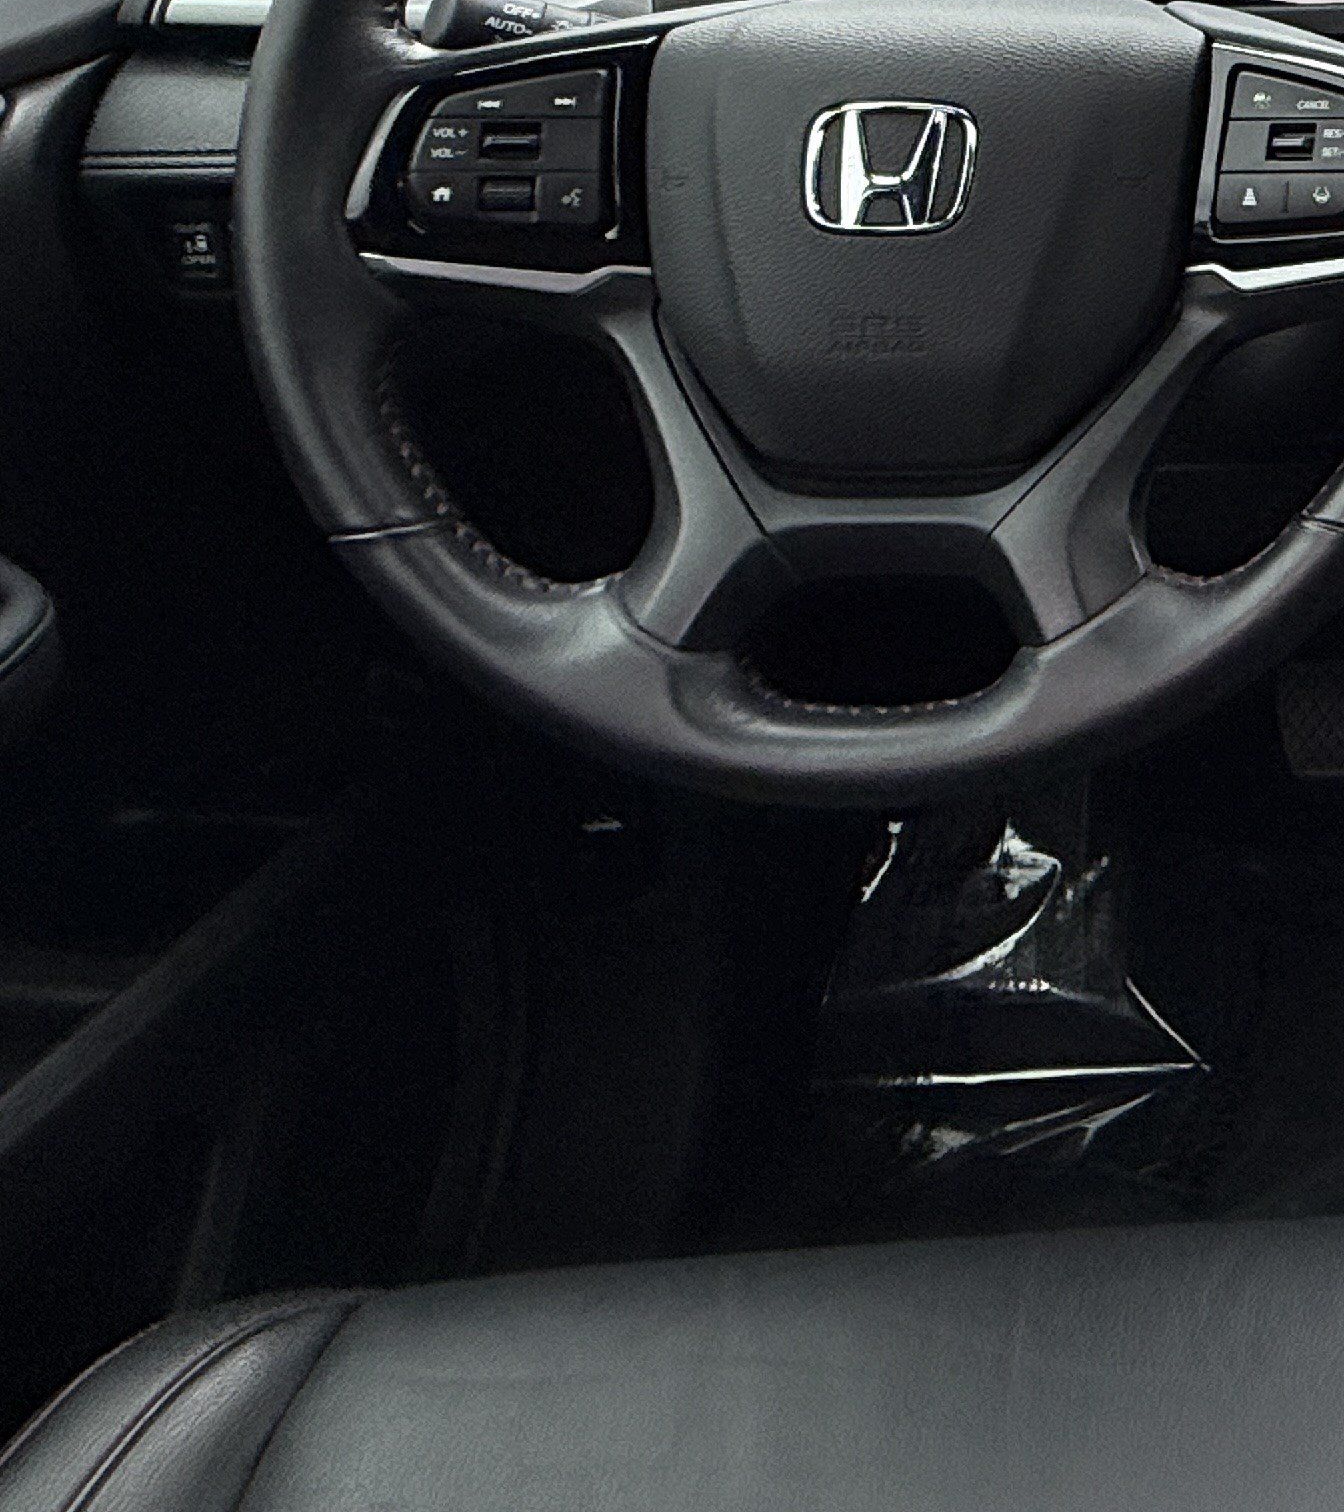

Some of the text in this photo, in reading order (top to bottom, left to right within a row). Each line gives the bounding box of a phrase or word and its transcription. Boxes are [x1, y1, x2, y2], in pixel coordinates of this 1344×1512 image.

[502, 2, 534, 18] OFF
[484, 15, 527, 35] AUTO
[432, 127, 456, 139] VOL
[430, 147, 454, 159] VOL
